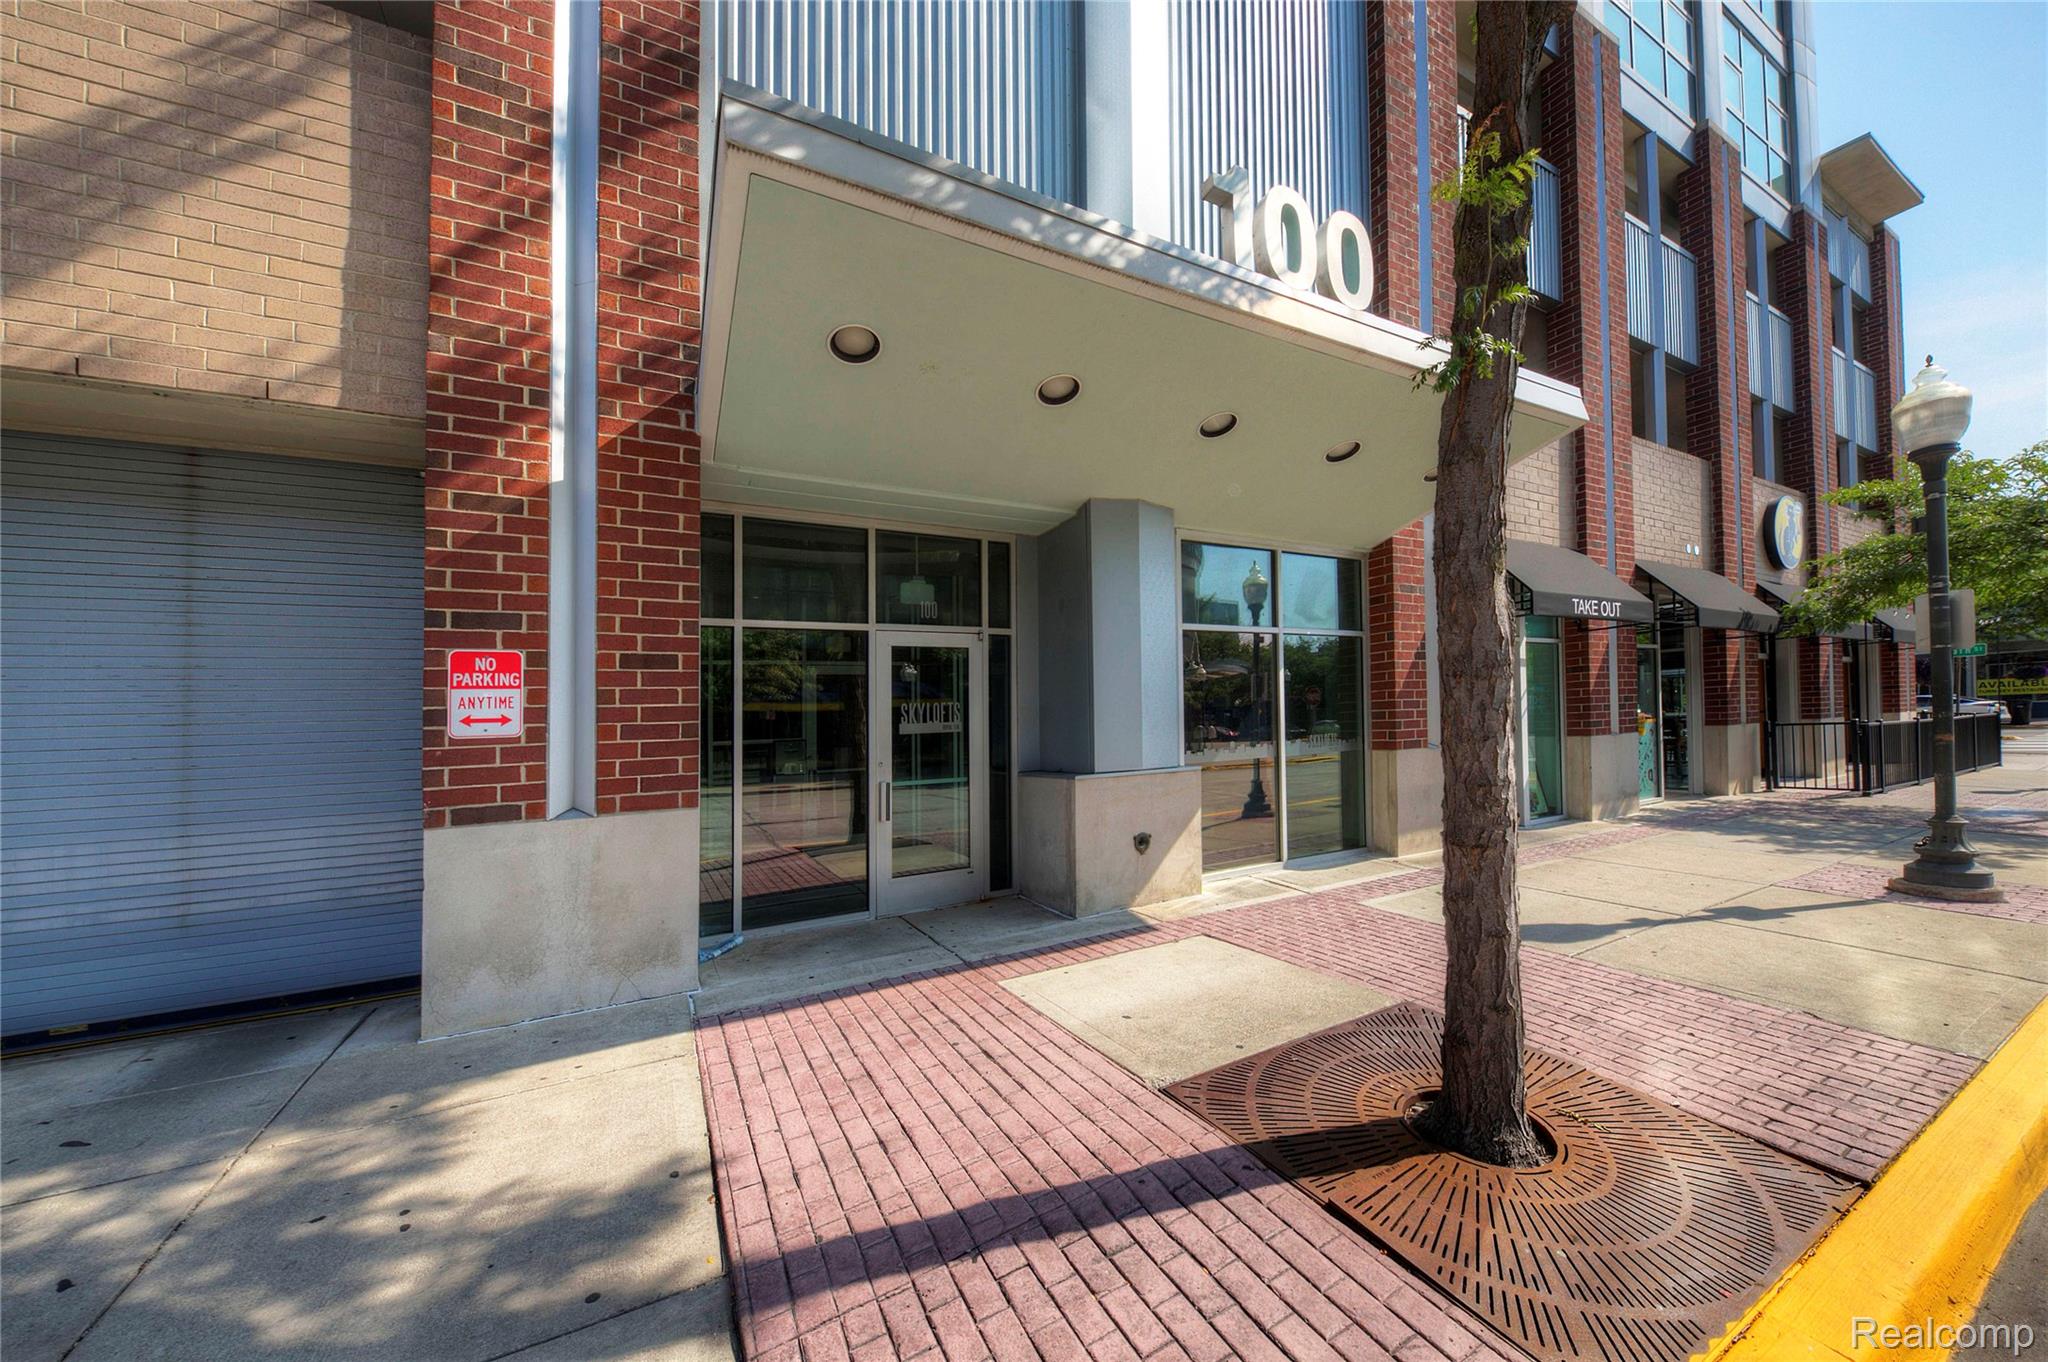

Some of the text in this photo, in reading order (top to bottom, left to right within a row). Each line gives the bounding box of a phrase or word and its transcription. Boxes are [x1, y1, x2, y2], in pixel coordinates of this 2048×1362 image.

[1201, 165, 1374, 311] 100
[920, 601, 938, 619] 100
[1572, 598, 1622, 617] TAKE OUT
[475, 657, 496, 671] NO
[452, 672, 520, 687] PARKING
[458, 696, 515, 710] ANYTIME
[900, 702, 961, 724] SKYLOFTS
